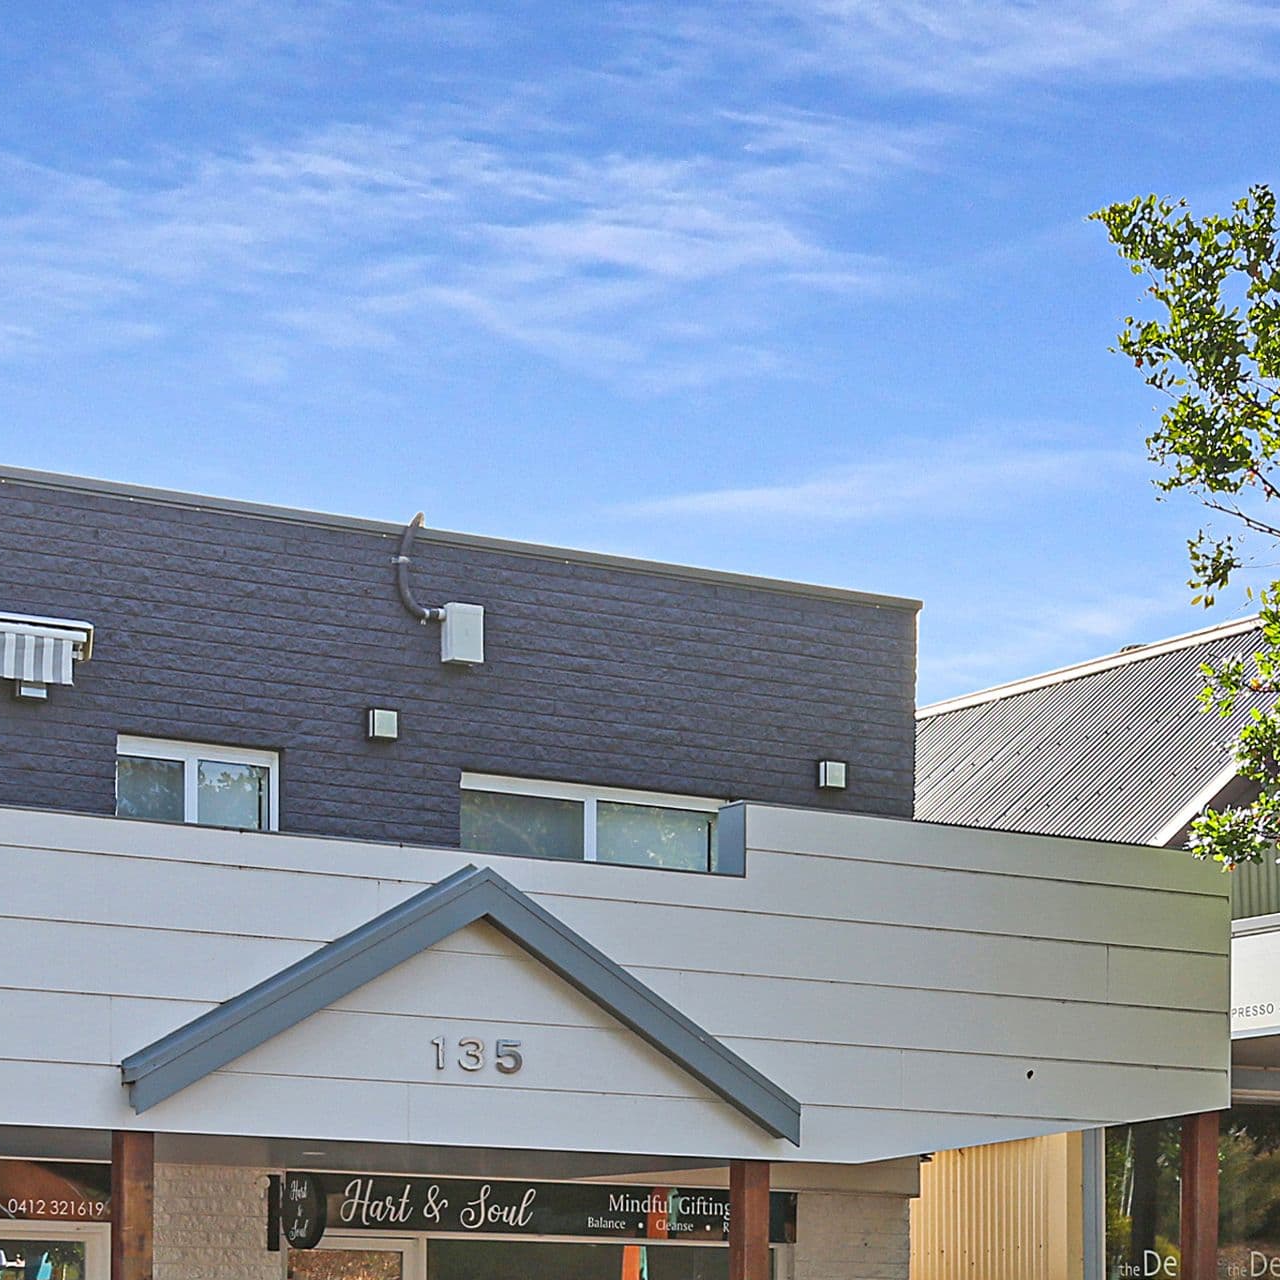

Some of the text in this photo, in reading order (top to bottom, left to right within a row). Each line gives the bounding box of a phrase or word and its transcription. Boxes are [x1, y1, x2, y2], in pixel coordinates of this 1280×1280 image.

[431, 1036, 524, 1075] 135
[7, 1198, 105, 1218] 0412 321619
[339, 1178, 537, 1230] Hart & Soul
[608, 1194, 731, 1222] Mindful Gifting
[587, 1216, 695, 1233] Balance Cleanse
[1119, 1259, 1141, 1278] the
[1227, 1258, 1248, 1278] the
